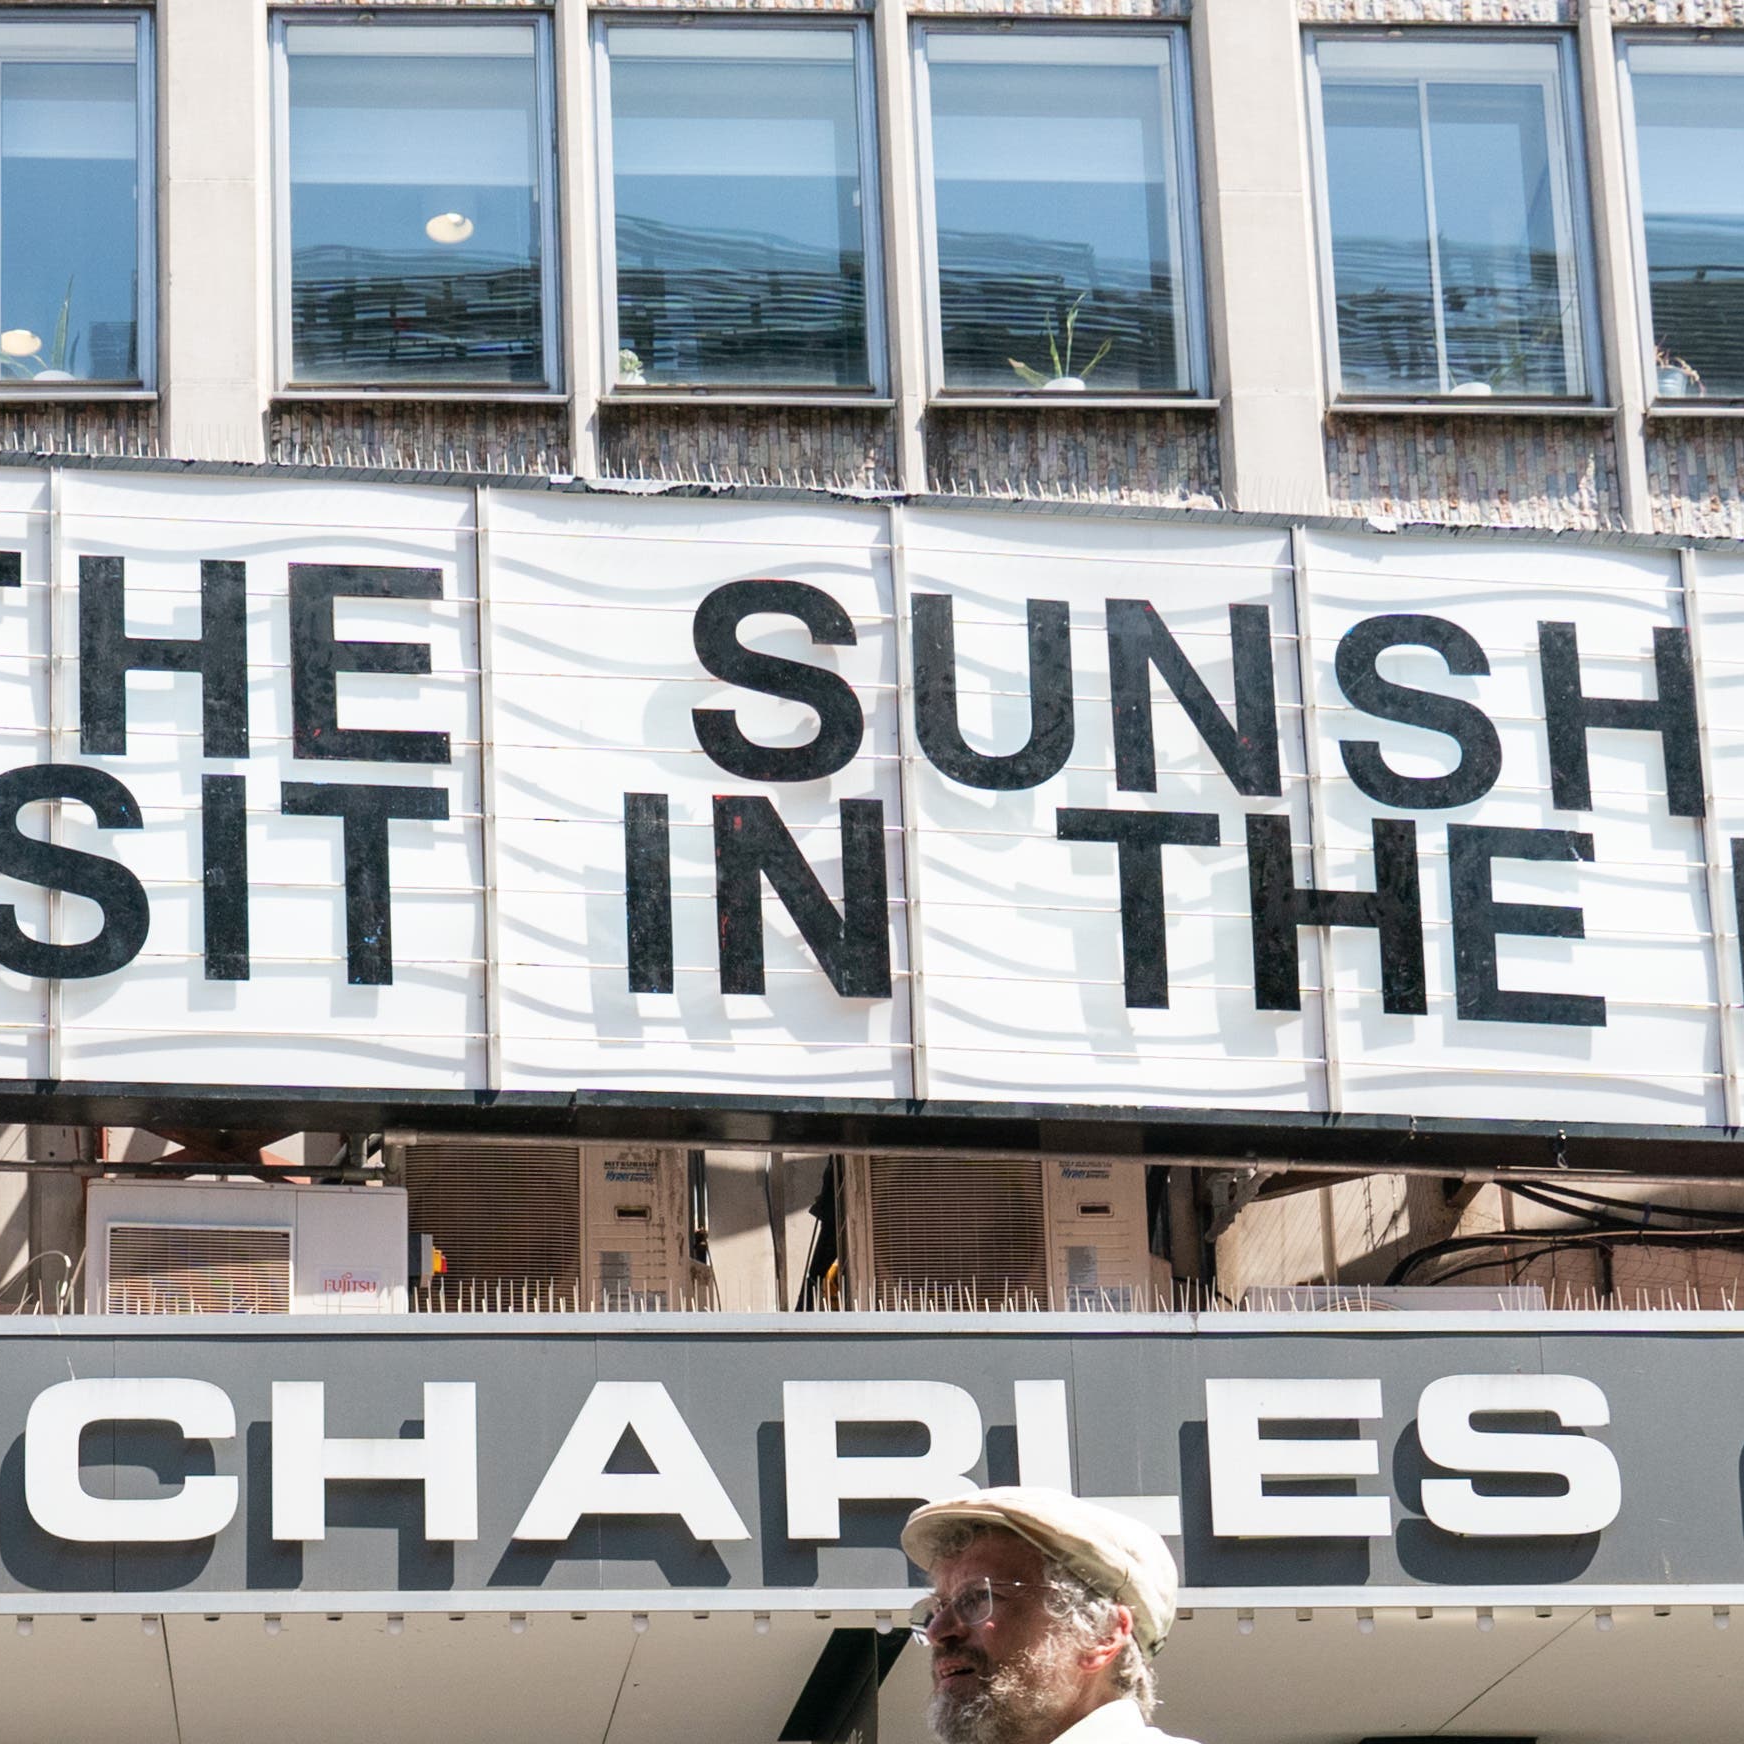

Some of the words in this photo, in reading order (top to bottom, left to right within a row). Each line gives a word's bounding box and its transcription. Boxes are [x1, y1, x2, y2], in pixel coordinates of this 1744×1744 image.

[624, 791, 892, 999] IN
[1055, 805, 1605, 1027] THE
[324, 1278, 377, 1295] FUJITSU
[22, 1372, 1624, 1546] CHARLES
